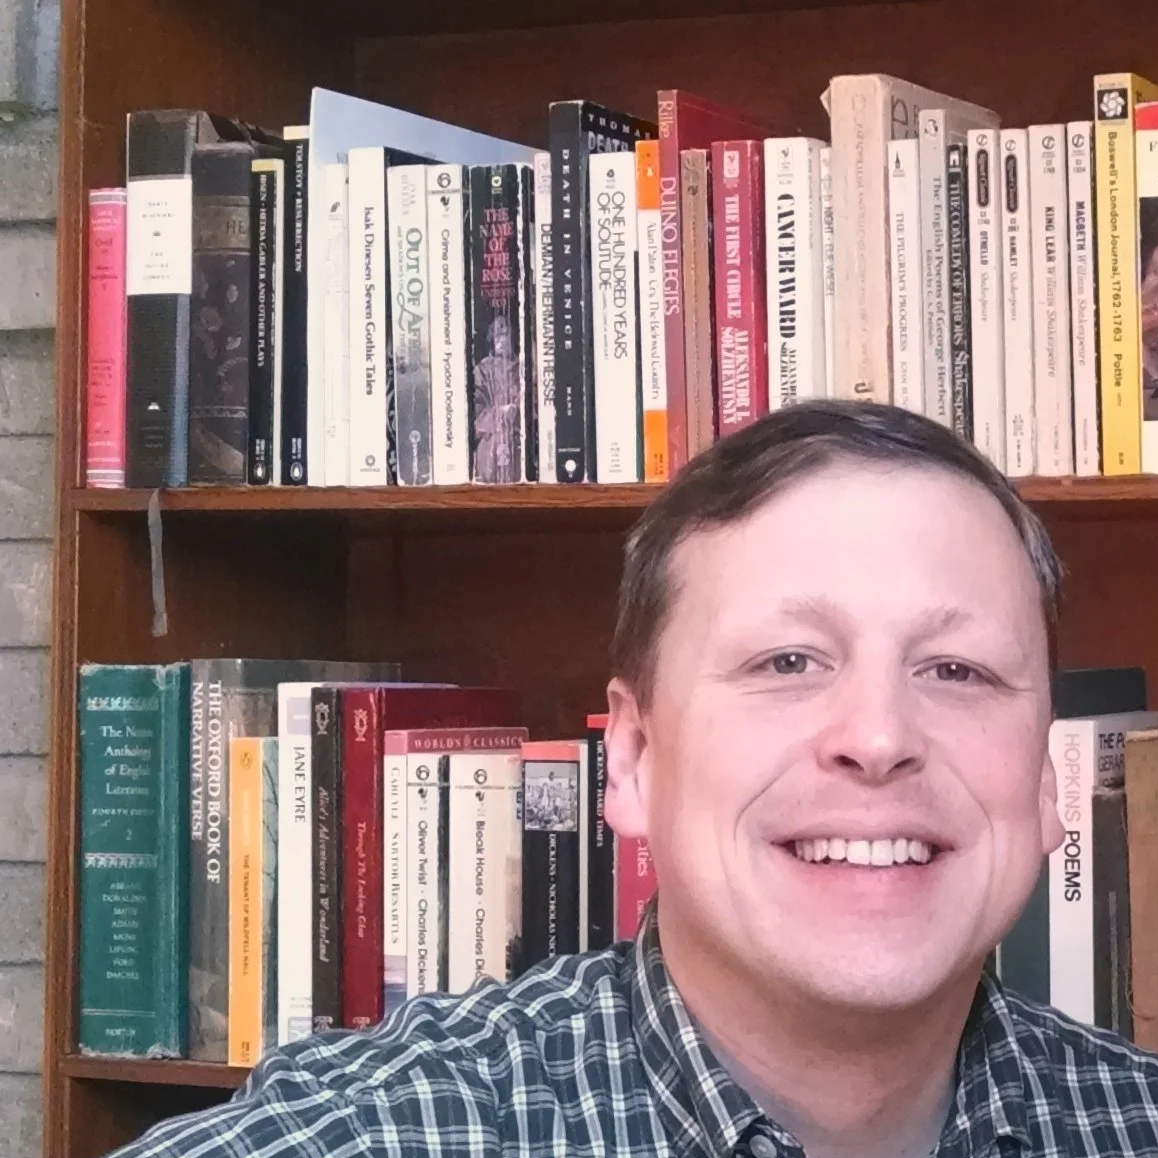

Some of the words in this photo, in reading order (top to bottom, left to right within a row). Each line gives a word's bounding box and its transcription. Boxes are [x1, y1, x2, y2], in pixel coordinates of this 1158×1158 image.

[658, 100, 674, 138] Rilke
[562, 149, 570, 219] DEATH
[598, 192, 612, 214] OF
[364, 206, 375, 231] Isak
[612, 191, 626, 228] ONE
[661, 177, 678, 243] DUINO
[1045, 206, 1056, 232] KING
[1076, 201, 1086, 251] MACBETH
[1110, 187, 1120, 231] London
[406, 226, 424, 272] OUT
[440, 229, 450, 261] Crime
[598, 217, 612, 291] SOLITUDE
[777, 193, 796, 272] CANCER
[980, 230, 990, 266] OTHELLO
[1009, 236, 1018, 267] HAMLET
[1046, 236, 1056, 263] LEAR
[364, 233, 375, 281] Dinesen
[441, 264, 450, 285] and
[613, 232, 627, 308] HUNDRED
[934, 259, 945, 290] Poems
[364, 284, 375, 320] Seven
[664, 248, 680, 316] ELEGIES
[563, 269, 572, 349] VENICE
[778, 274, 796, 338] WARD
[898, 296, 908, 352] PROGRESS
[364, 322, 376, 362] Gothic
[614, 311, 628, 359] YEARS
[364, 365, 376, 396] Tales
[440, 353, 452, 389] Fyodor
[207, 680, 221, 717] THE
[102, 725, 122, 738] The
[192, 681, 204, 783] NARRATIVE
[207, 719, 221, 797] OXFORD
[294, 746, 306, 783] JANE
[1064, 733, 1081, 822] HOPKINS
[192, 788, 204, 841] VERSE
[208, 800, 220, 854] BOOK
[293, 786, 306, 824] EYRE
[318, 824, 329, 882] Adventures
[390, 833, 400, 880] SARTOR
[417, 820, 428, 857] Oliver
[474, 820, 486, 855] Bleak
[549, 834, 557, 876] DICKENS
[208, 858, 220, 884] OF
[418, 858, 428, 886] Twist
[475, 857, 486, 896] House
[1064, 830, 1081, 902] POEMS
[318, 897, 329, 963] Wonderland
[391, 882, 400, 945] RESARTUS
[418, 899, 428, 946] Charles
[474, 908, 486, 956] Charles
[549, 884, 557, 934] NICHOLAS
[418, 948, 428, 994] Dickens
